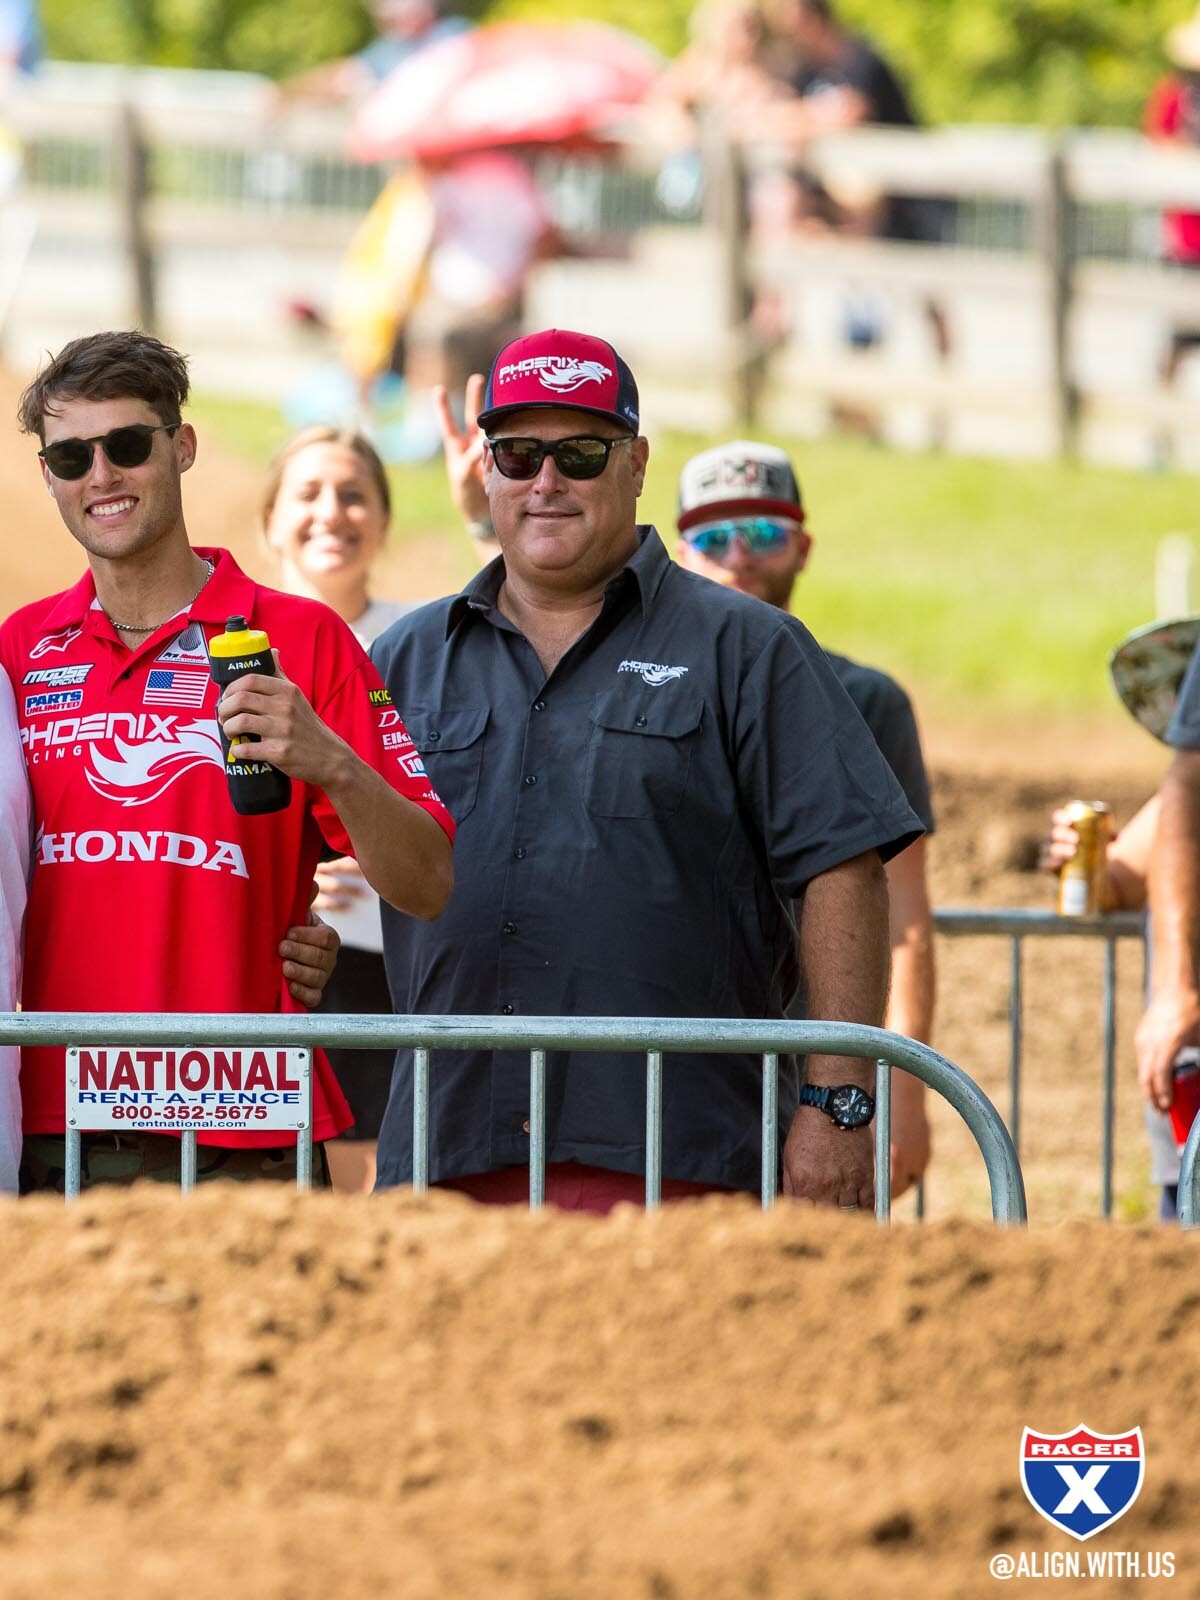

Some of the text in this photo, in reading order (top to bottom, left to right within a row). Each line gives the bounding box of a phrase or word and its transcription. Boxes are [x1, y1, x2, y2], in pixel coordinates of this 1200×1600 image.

[499, 356, 580, 379] PHOENIX
[500, 370, 538, 385] RACING
[227, 659, 261, 670] ARMA
[22, 664, 94, 685] MOOSE
[27, 691, 82, 709] PARTS
[27, 701, 80, 715] UNLIMITED
[20, 712, 179, 750] PHOENIX
[39, 830, 250, 880] HONDA
[79, 1050, 300, 1092] NATIONAL
[78, 1092, 300, 1104] RENT-A-FENCE
[111, 1105, 268, 1120] 800-352-5675
[131, 1120, 247, 1128] rentnational.com
